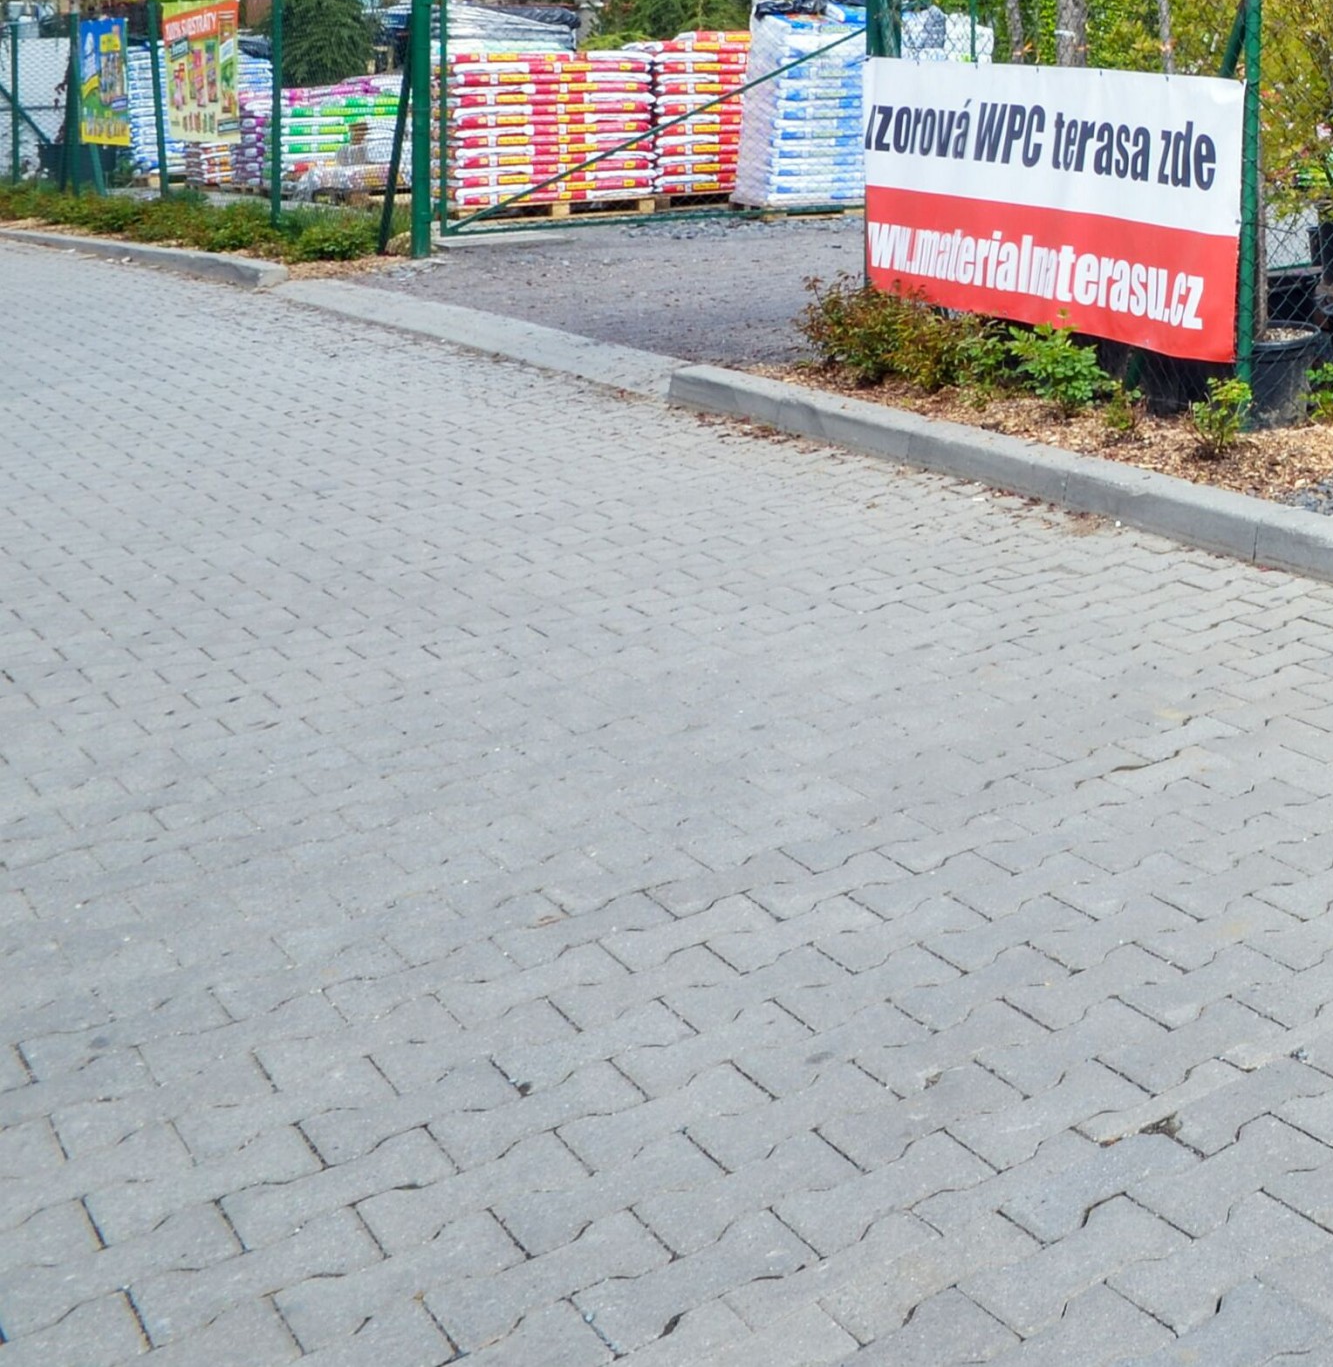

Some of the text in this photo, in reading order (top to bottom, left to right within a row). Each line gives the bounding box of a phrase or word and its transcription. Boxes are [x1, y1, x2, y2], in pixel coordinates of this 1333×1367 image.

[865, 98, 1217, 192] zorová WPC terasa zde
